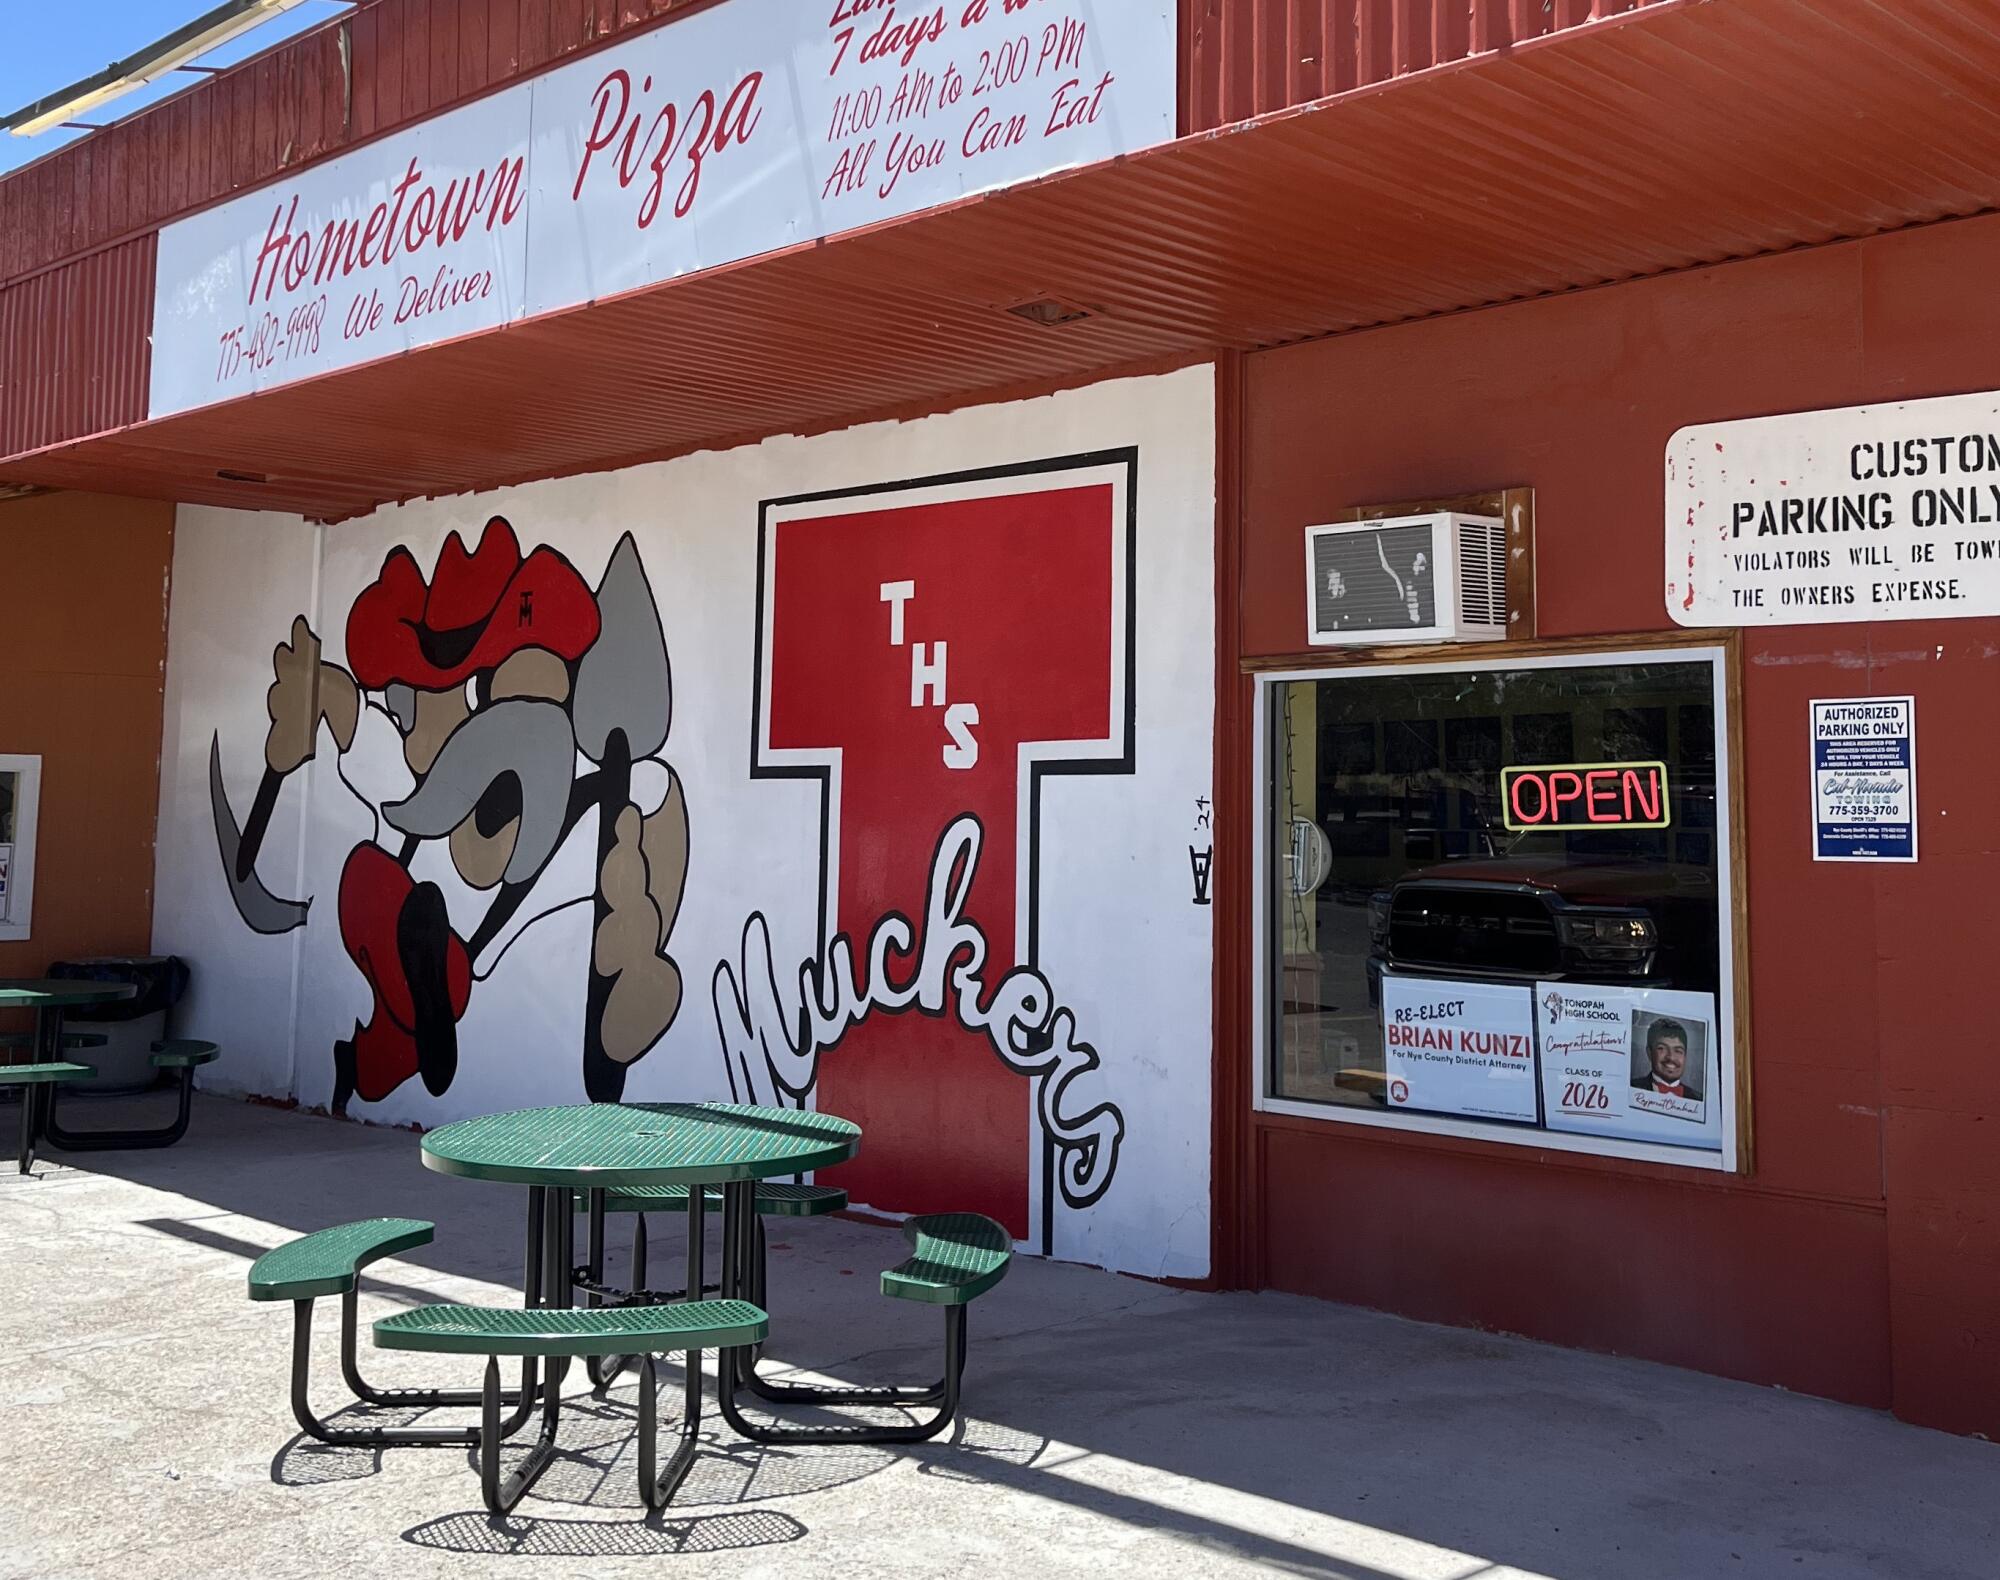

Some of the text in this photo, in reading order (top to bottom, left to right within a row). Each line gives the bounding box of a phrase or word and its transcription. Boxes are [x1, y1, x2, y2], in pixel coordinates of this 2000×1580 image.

[829, 0, 989, 76] 7 days a
[828, 16, 1086, 142] 11:00 AM to 2:00 PM
[821, 71, 1115, 200] All You Can Eat
[248, 69, 764, 305] Hometown Pizza
[217, 265, 494, 383] 775-482-9998 We Deliver
[1732, 492, 1893, 538] PARKING
[1733, 540, 2000, 572] VIOLATORS WILL BE TOW
[1733, 579, 1967, 607] THE OWNERS EXPENSE.
[1824, 707, 1899, 721] AUTHORIZED
[1819, 722, 1904, 736] PARKING ONLY
[1511, 770, 1660, 824] OPEN
[1829, 805, 1899, 815] 775-359-3700
[1836, 795, 1891, 805] TOWING
[712, 811, 1125, 1208] Muckers
[1394, 1001, 1465, 1023] RE-ELECT
[1564, 998, 1605, 1010] TONOPAH
[1565, 1008, 1621, 1022] HIGH SCHOOL
[1388, 1024, 1531, 1059] BRIAN KUNZI
[1546, 1026, 1628, 1057] Congratulations!
[1392, 1049, 1527, 1072] For Nye County District Attorney
[1564, 1067, 1604, 1078] CLASS OF
[1561, 1082, 1609, 1110] 2026
